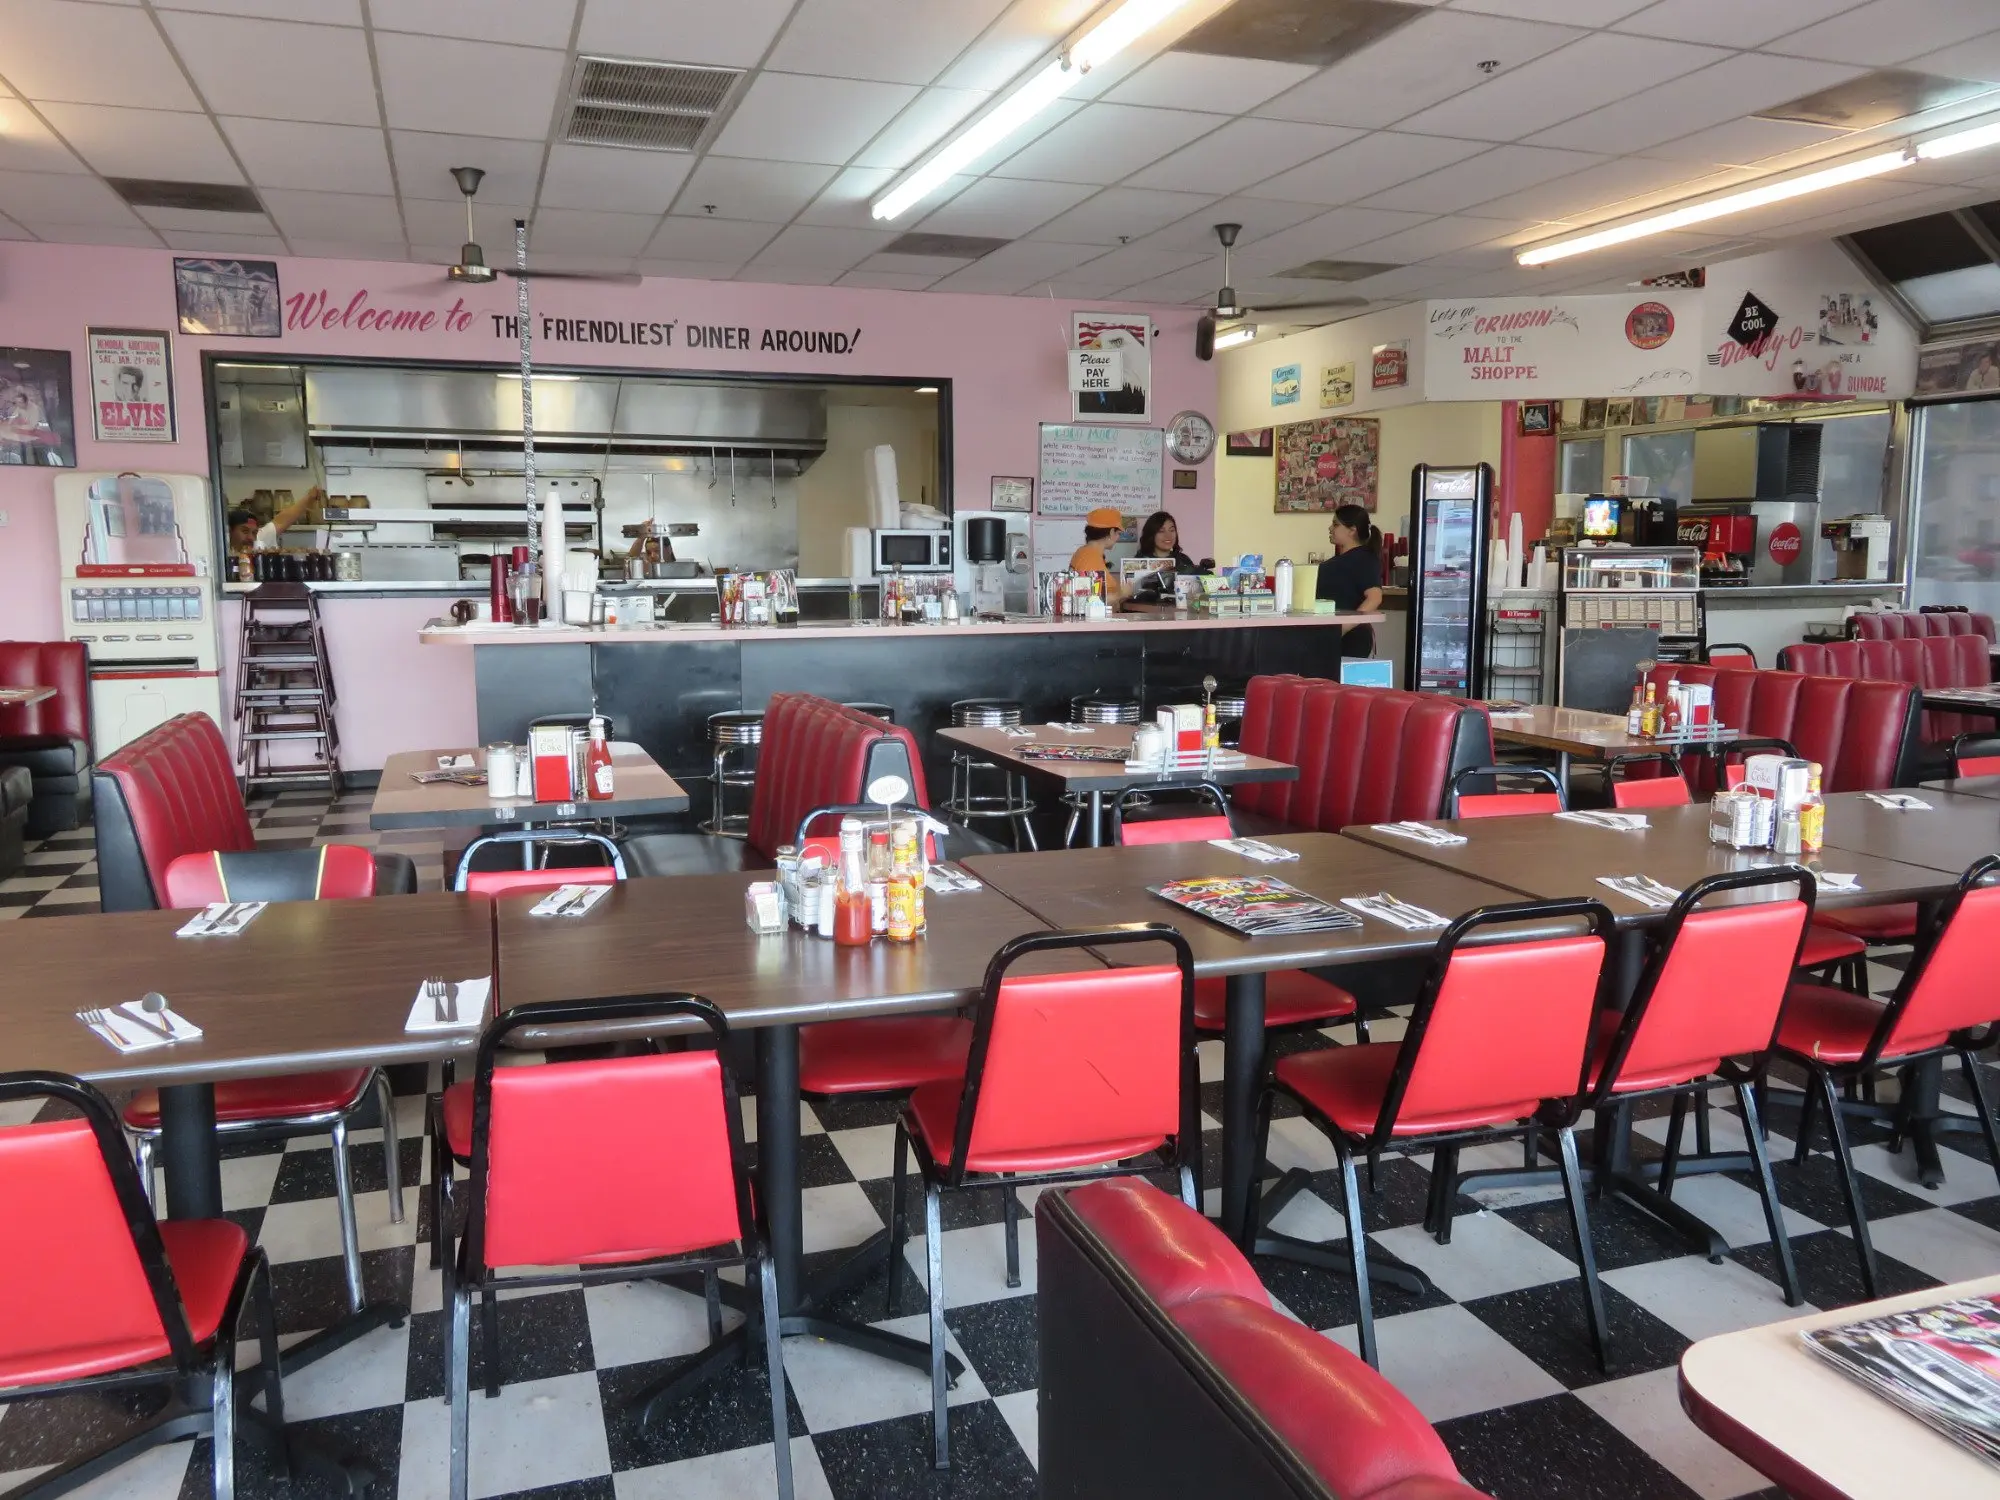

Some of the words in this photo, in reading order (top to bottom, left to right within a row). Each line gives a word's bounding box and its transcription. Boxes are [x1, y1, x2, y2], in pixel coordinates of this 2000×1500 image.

[1745, 306, 1759, 318] BE
[286, 289, 439, 331] Welcome
[446, 297, 476, 331] to
[687, 325, 749, 350] DINER
[761, 327, 861, 355] AROUND!
[1741, 317, 1766, 331] COOL
[1463, 346, 1514, 363] MALT
[1718, 326, 1803, 371] Daddy-O
[1080, 353, 1110, 365] Please
[1840, 353, 1853, 363] HAVE
[1855, 353, 1861, 363] A
[1086, 368, 1104, 378] PAY
[1471, 366, 1538, 380] SHOPPE
[1082, 378, 1109, 388] HERE
[1847, 376, 1887, 393] SUNDAE
[100, 401, 166, 427] ELVIS
[1770, 537, 1800, 550] Coca-Cola
[1751, 770, 1773, 784] Coke
